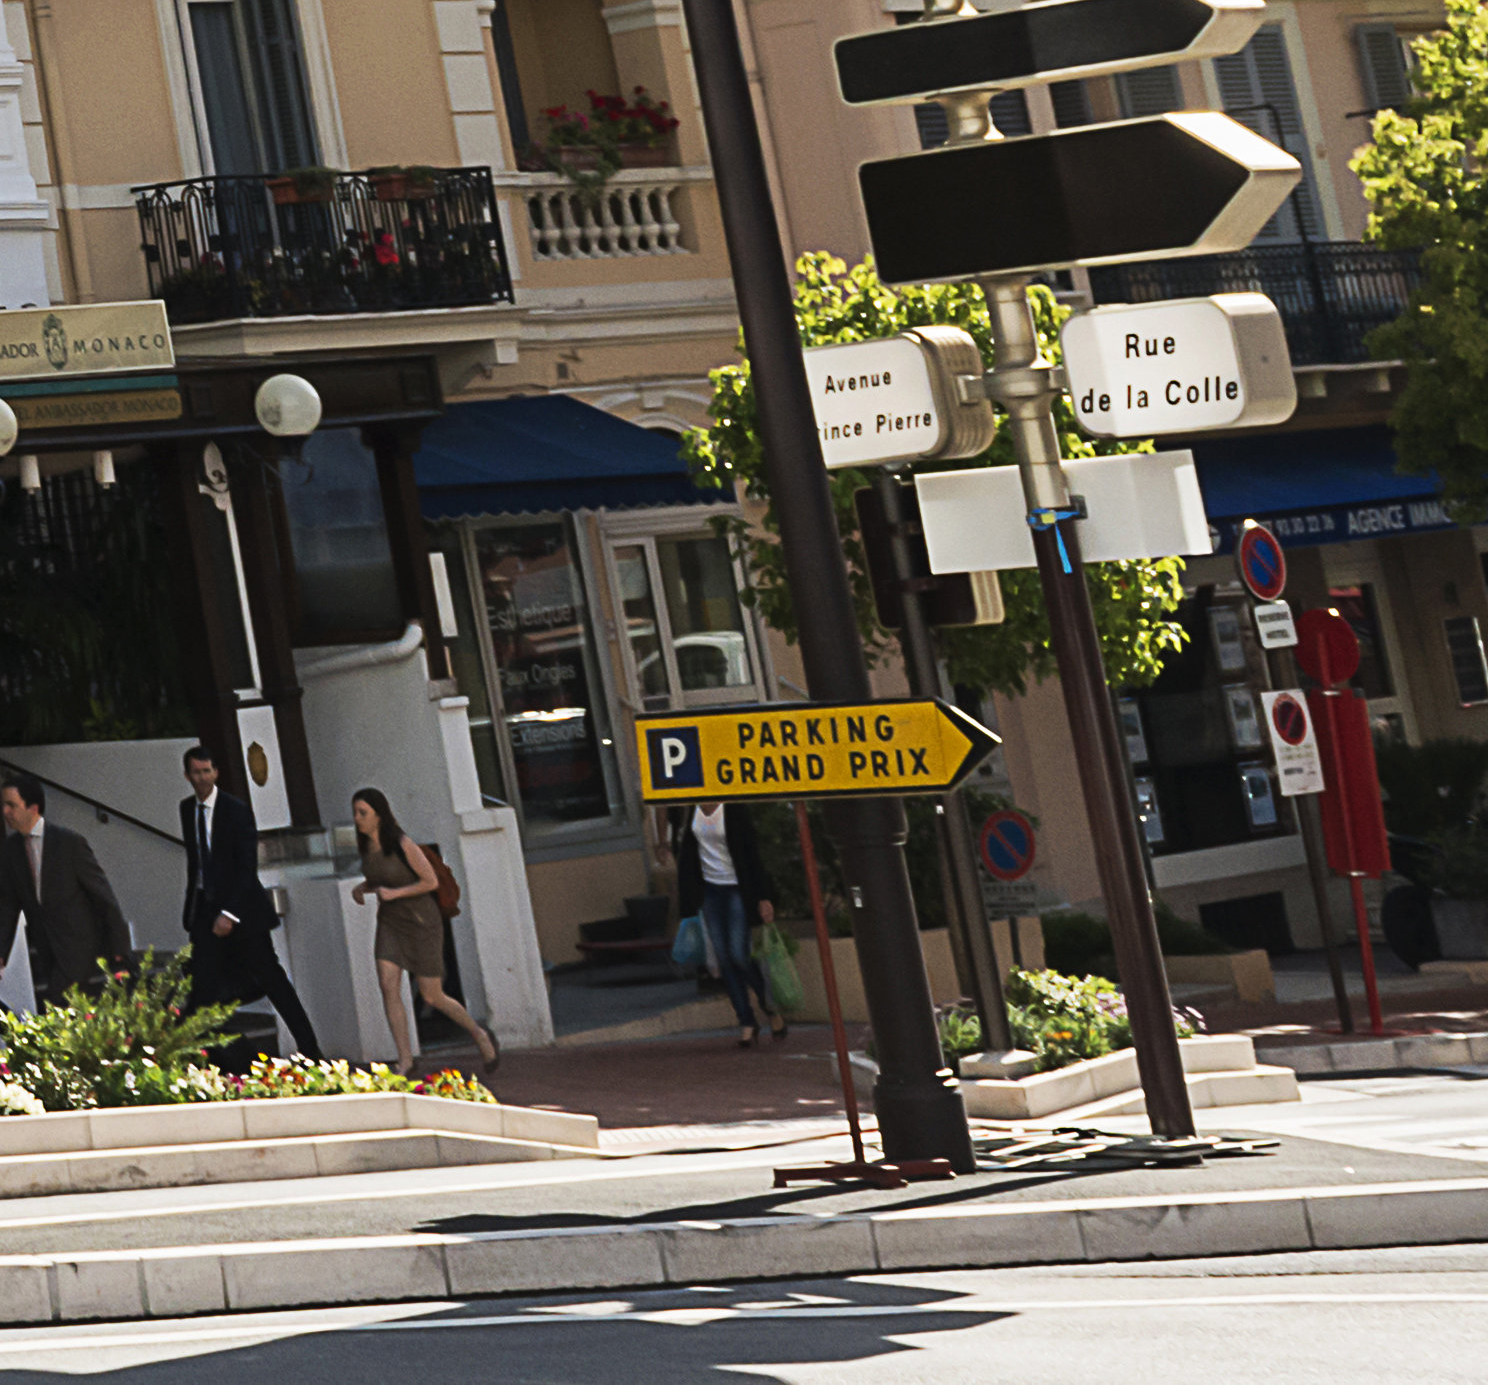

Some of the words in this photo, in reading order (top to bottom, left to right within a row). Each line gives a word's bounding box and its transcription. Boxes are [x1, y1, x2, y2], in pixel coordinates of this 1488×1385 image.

[73, 334, 165, 354] MONACO
[1125, 333, 1175, 358] Rue
[825, 371, 891, 394] Avenue
[1081, 388, 1111, 414] de
[1127, 385, 1149, 409] la
[1165, 376, 1238, 405] Colle
[818, 421, 863, 440] ince
[876, 413, 932, 433] Pierre
[1348, 505, 1405, 535] AGENCE
[532, 663, 576, 685] Ongles
[511, 723, 586, 747] Extensions
[738, 715, 894, 749] PARKING
[661, 737, 687, 779] P
[716, 753, 825, 785] GRAND
[848, 748, 931, 778] PRIX
